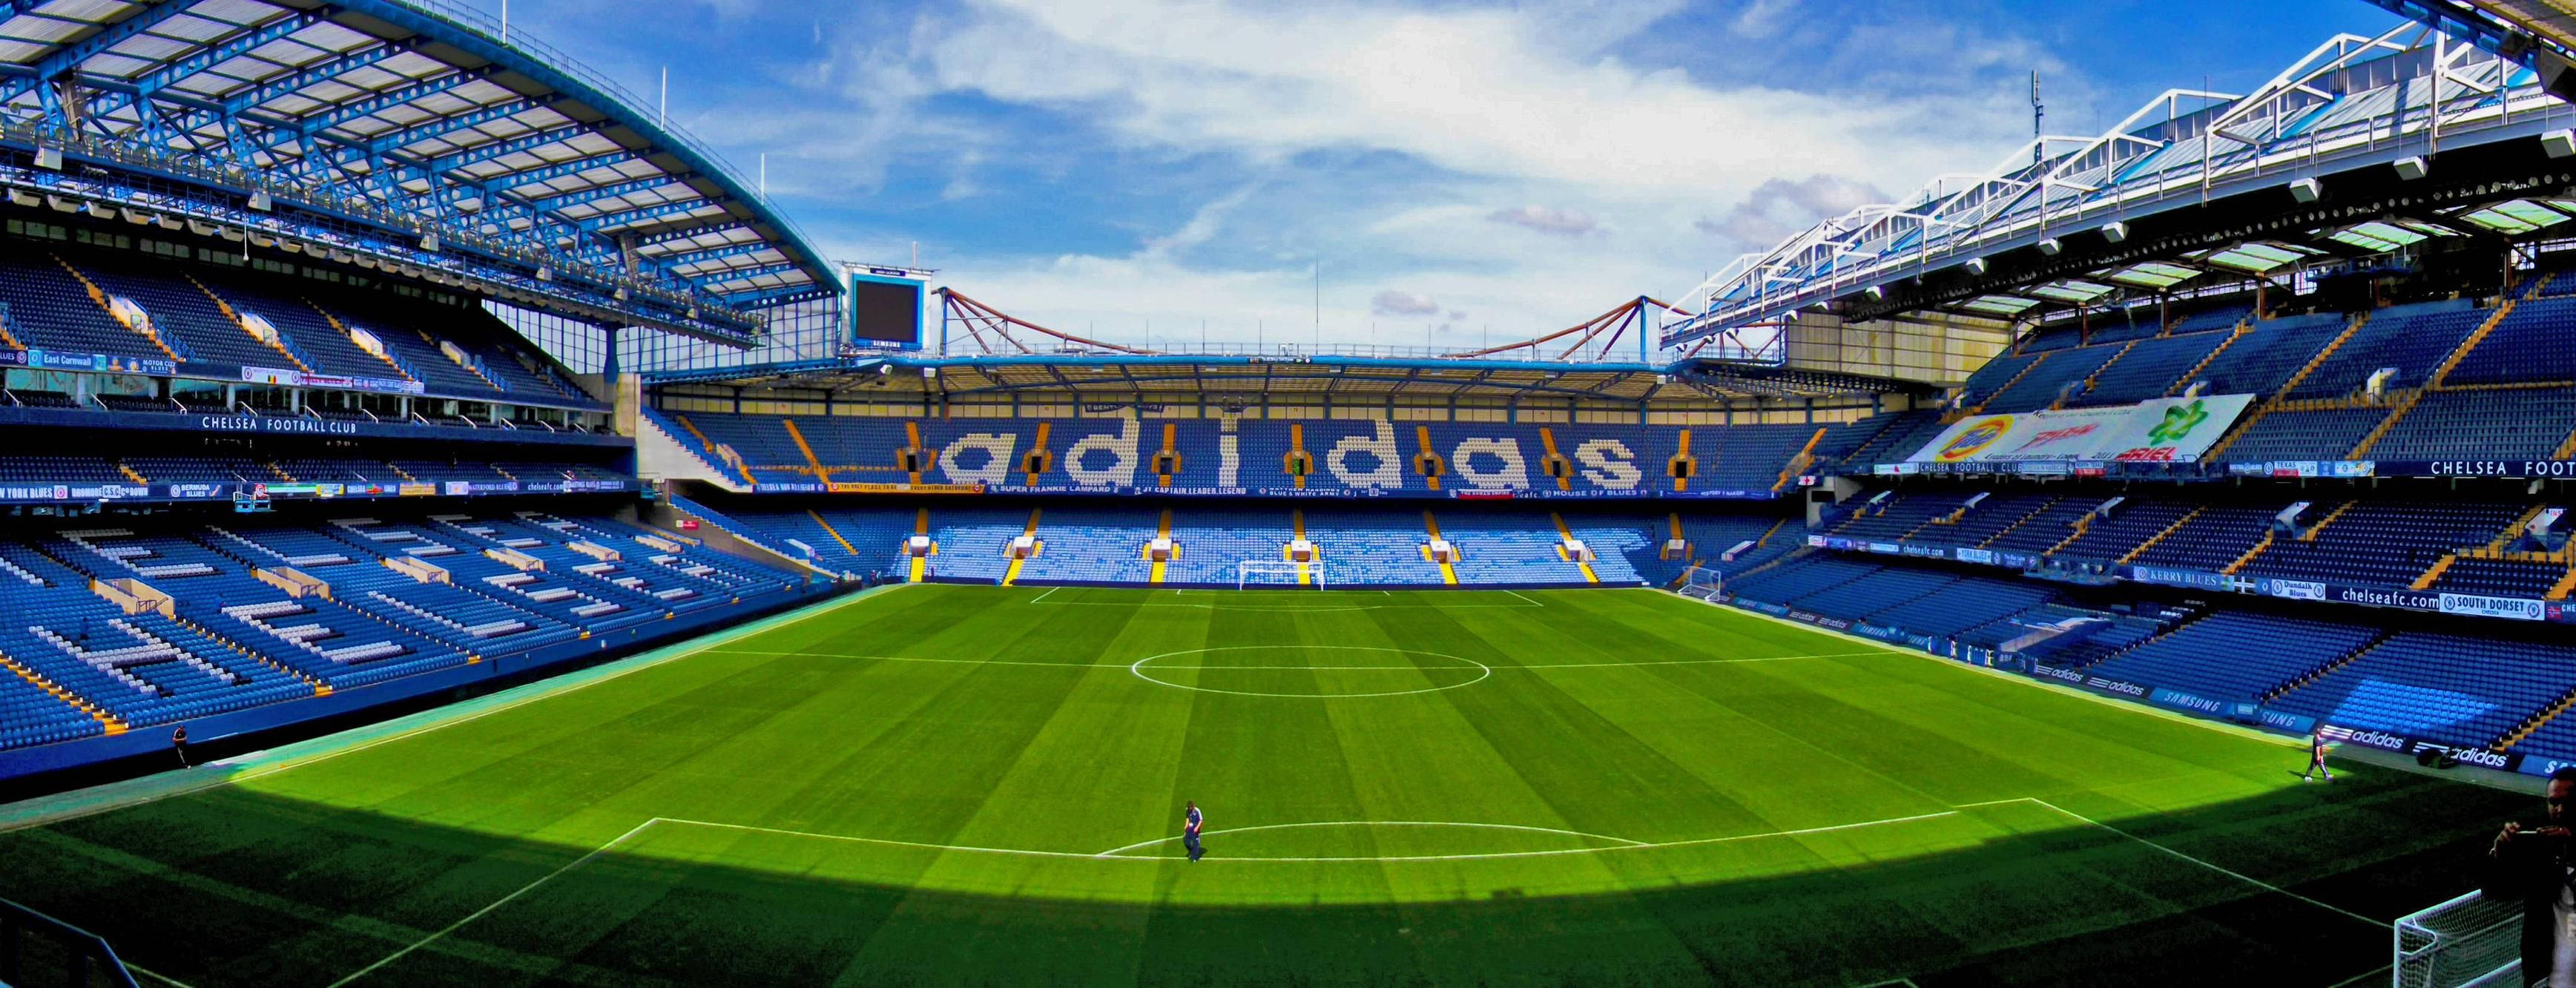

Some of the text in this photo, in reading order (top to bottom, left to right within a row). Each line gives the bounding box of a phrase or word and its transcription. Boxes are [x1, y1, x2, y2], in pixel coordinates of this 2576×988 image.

[44, 355, 91, 366] East Cornwall
[202, 417, 356, 433] CHELSEA FOOTBALL CLUB
[938, 415, 1641, 490] adidas
[1920, 463, 2022, 472] CHELSEA FOOTBALL CLUB
[2431, 461, 2506, 475] CHELSEA
[7, 487, 28, 498] YORK
[30, 487, 53, 498] BLUES
[130, 487, 148, 497] DOWN
[527, 481, 564, 491] chelseafc.com
[1069, 485, 1111, 493] LAMPARD
[1903, 545, 1944, 556] chelseafc.com
[2150, 570, 2217, 586] KERRY BLUES
[2284, 582, 2313, 590] Dundalk
[2289, 590, 2307, 598] Blues
[2342, 587, 2440, 608] chelseafc.com
[2457, 596, 2525, 613] SOUTH DORSET
[2052, 668, 2083, 682] adidas
[2109, 681, 2144, 696] adidas
[2164, 692, 2221, 712] SAMSUNG
[2262, 711, 2296, 727] SUNG
[2352, 730, 2403, 750] adidas
